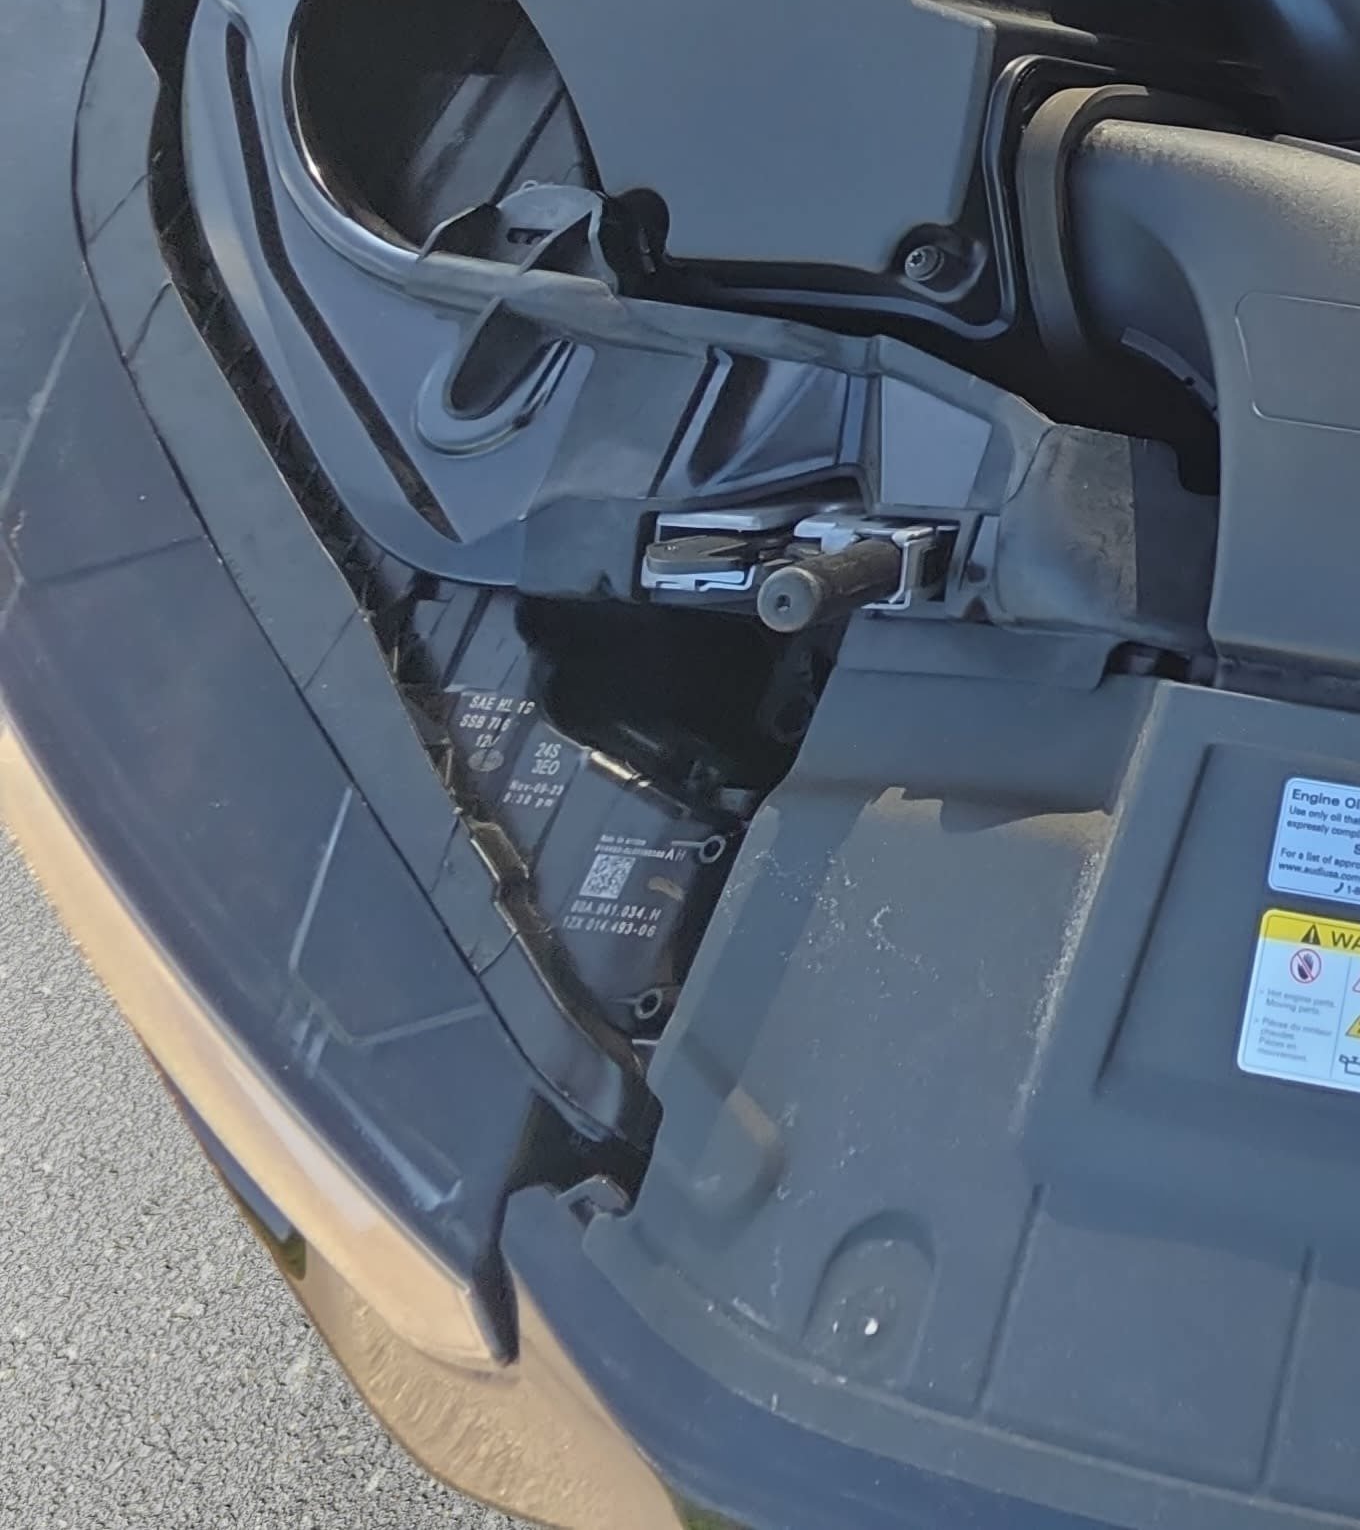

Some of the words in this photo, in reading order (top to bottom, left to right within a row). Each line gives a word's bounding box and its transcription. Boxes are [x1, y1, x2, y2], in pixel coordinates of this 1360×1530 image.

[1291, 789, 1340, 808] Engine
[1288, 806, 1306, 816] Use
[1308, 809, 1327, 820] only
[1330, 812, 1341, 822] oil
[1343, 815, 1360, 825] that
[1286, 820, 1328, 834] expressly
[1280, 847, 1296, 858] For
[1305, 852, 1320, 862] list
[1321, 854, 1332, 864] of
[1278, 861, 1360, 882] www.audiusa.com
[1265, 998, 1296, 1011] Moving
[1267, 989, 1281, 997] Hot
[1283, 993, 1311, 1004] engine
